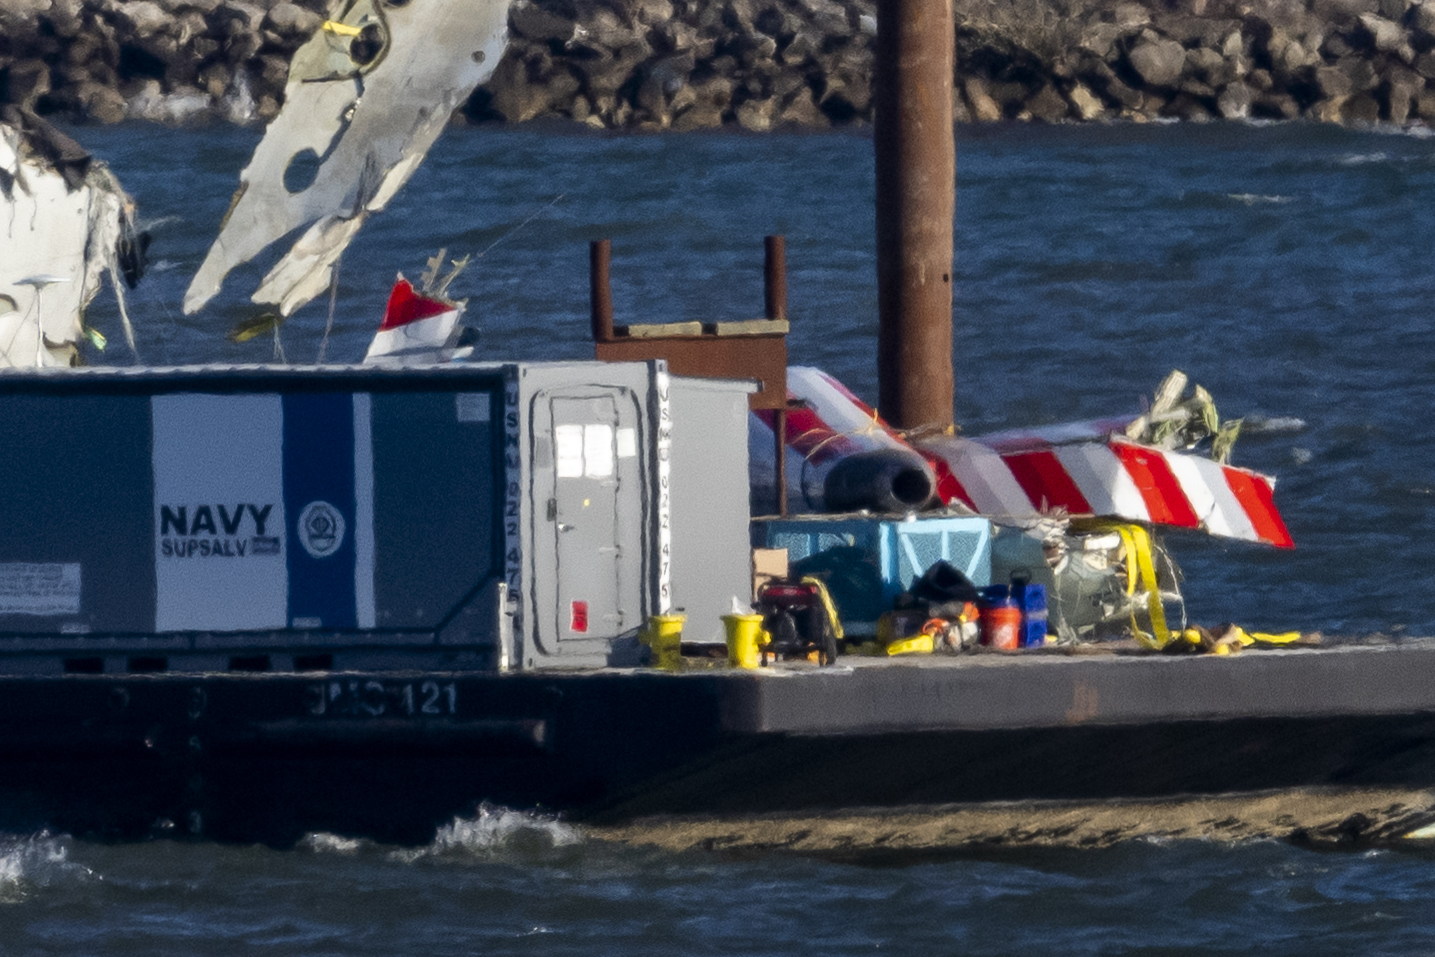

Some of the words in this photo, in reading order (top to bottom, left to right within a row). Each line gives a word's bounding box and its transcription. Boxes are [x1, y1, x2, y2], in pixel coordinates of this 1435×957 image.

[160, 504, 273, 536] NAVY
[161, 537, 248, 558] SUPSALV
[402, 679, 457, 716] 121
